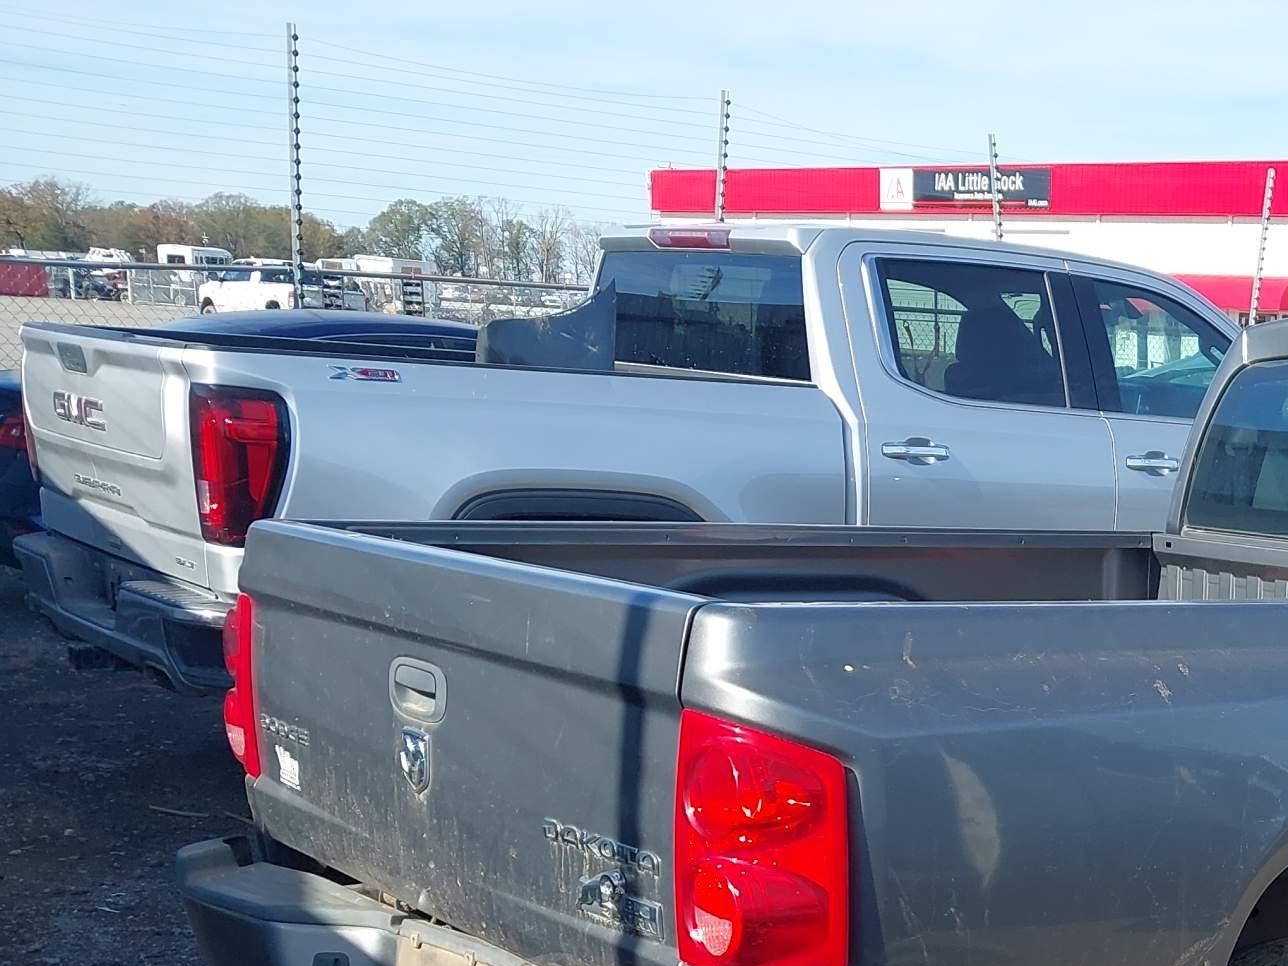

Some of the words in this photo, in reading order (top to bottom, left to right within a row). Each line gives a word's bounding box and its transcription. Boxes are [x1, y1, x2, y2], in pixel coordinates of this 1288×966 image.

[935, 172, 955, 191] IAA
[958, 172, 989, 191] Little
[53, 391, 106, 432] GMC
[260, 713, 310, 746] DODGE
[543, 817, 662, 880] DAKOTA
